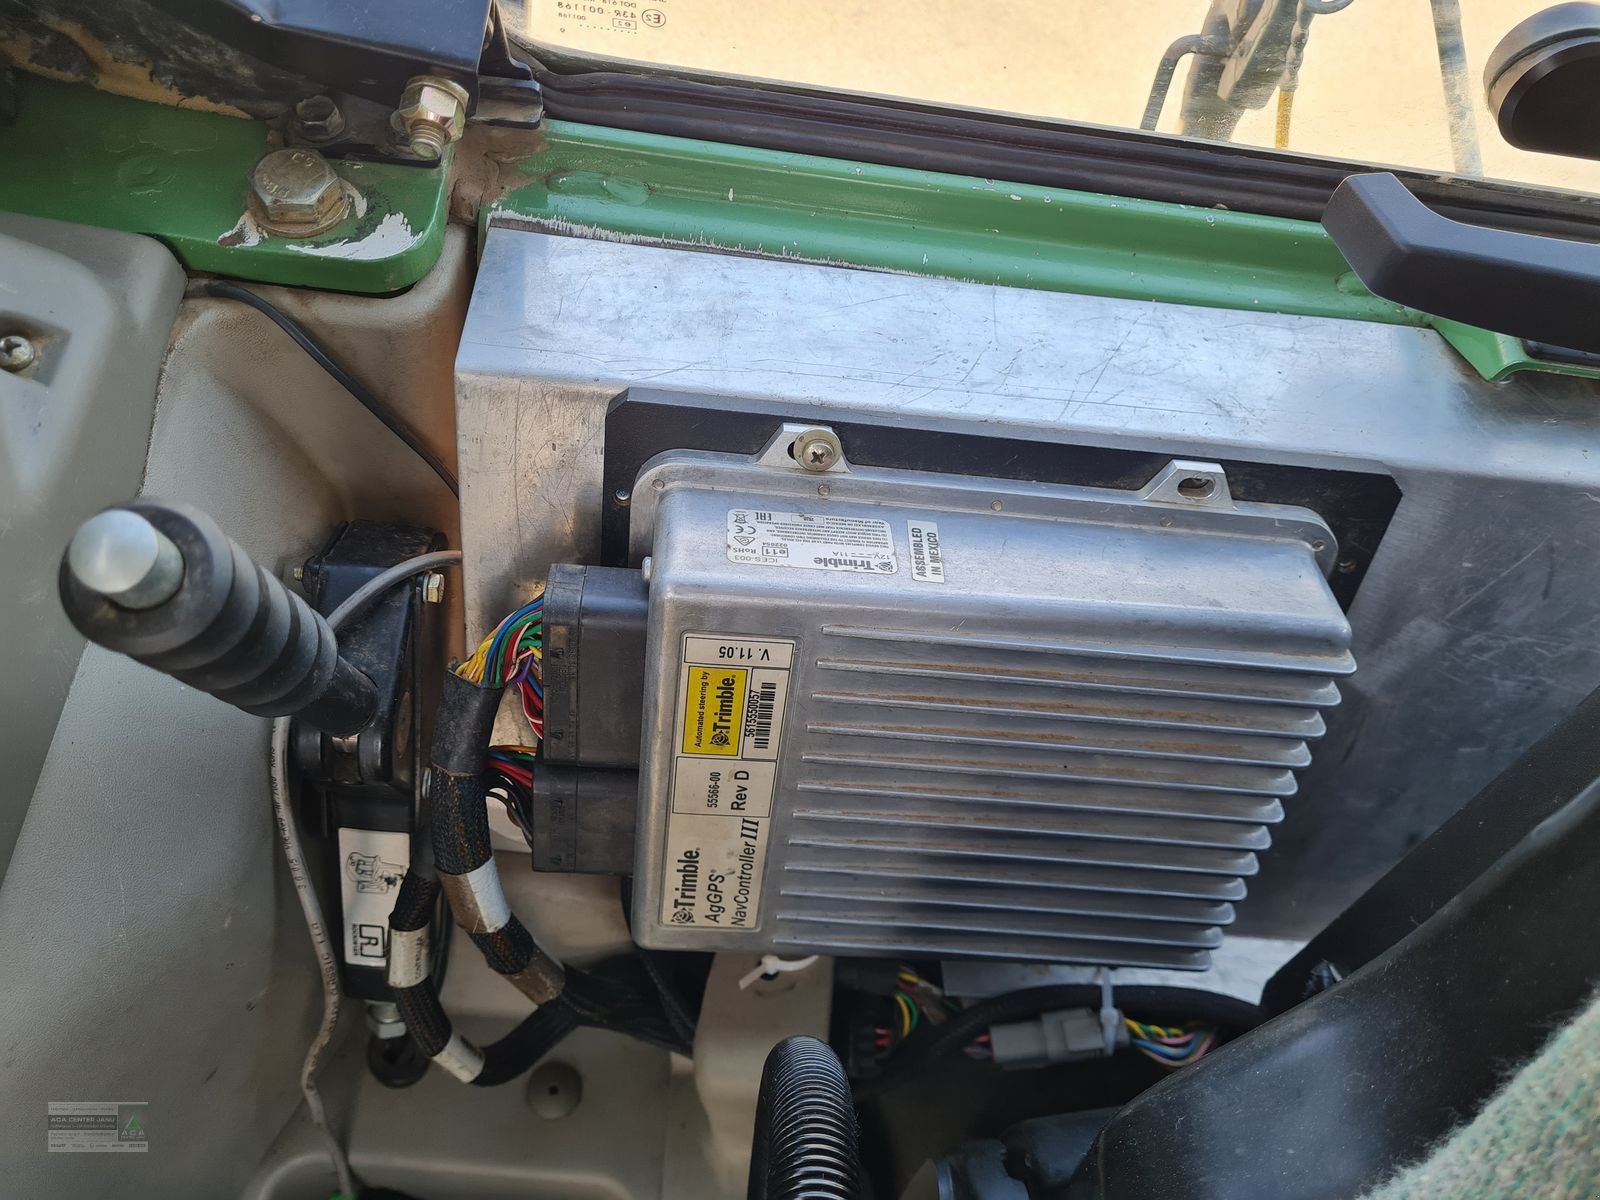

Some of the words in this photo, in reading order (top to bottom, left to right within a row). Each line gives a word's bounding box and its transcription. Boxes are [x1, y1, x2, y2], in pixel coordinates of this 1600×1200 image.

[734, 554, 778, 563] ICES-003
[911, 527, 927, 578] ASSEMBLED
[926, 532, 941, 564] MEXICO
[813, 556, 875, 571] Trimble
[931, 566, 942, 576] IN
[719, 646, 753, 660] 11.05
[758, 648, 770, 661] V.
[700, 671, 711, 681] by
[697, 682, 709, 710] steering
[712, 676, 736, 732] Trimble
[744, 689, 761, 738] 5615550057
[694, 711, 705, 748] Automated
[707, 771, 721, 808] 55566-00
[734, 770, 750, 781] D
[730, 784, 748, 811] Rev
[740, 817, 760, 841] III
[674, 849, 700, 909] Trimble
[731, 841, 756, 927] NavController
[704, 873, 725, 924] AgGPS
